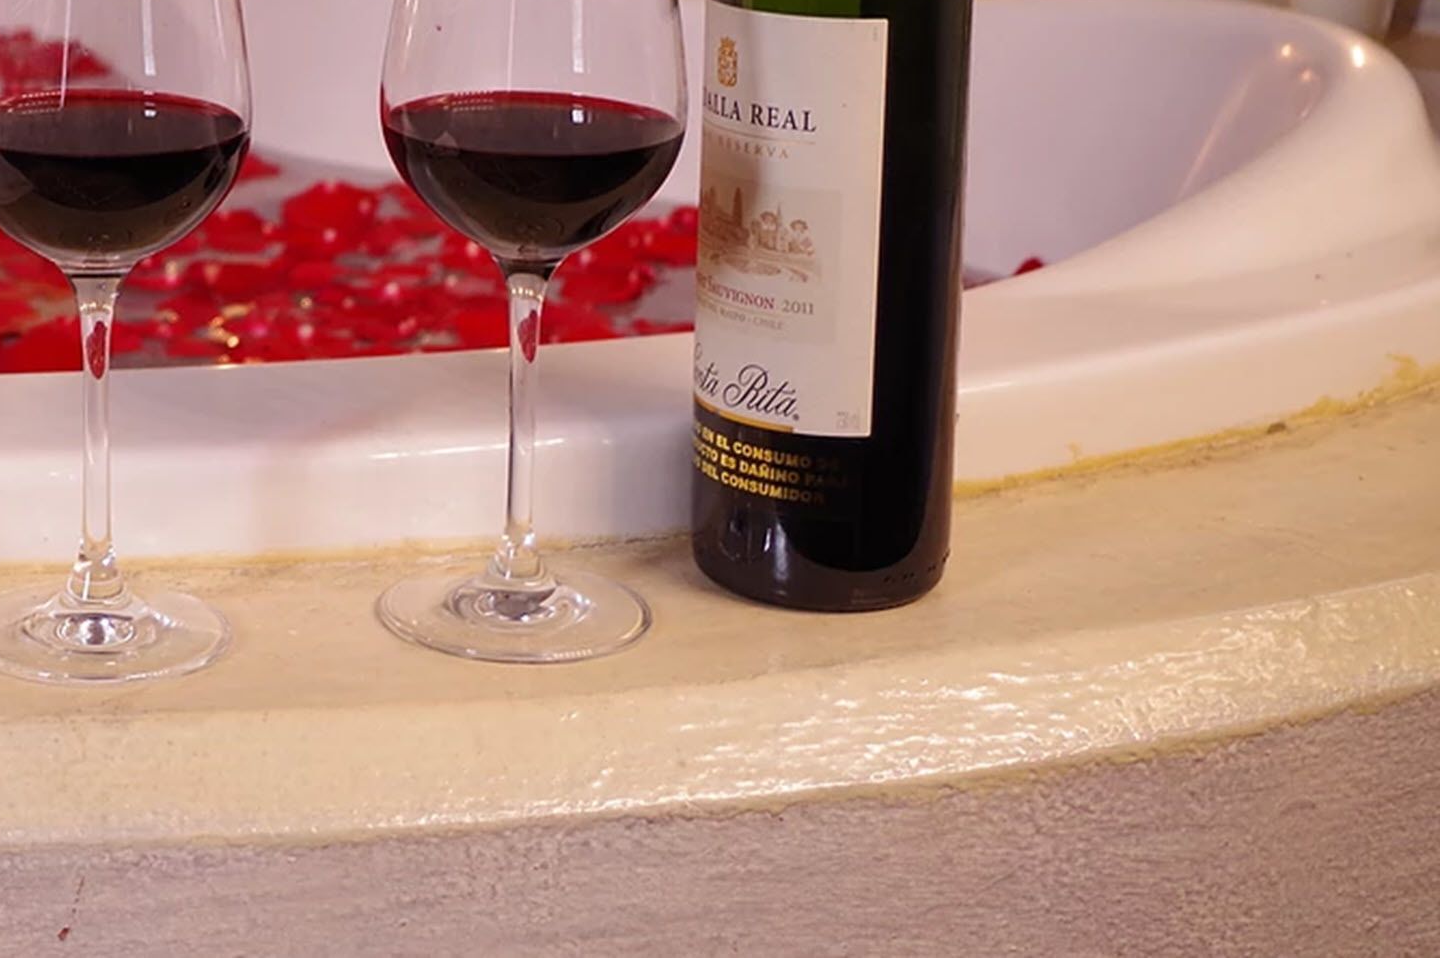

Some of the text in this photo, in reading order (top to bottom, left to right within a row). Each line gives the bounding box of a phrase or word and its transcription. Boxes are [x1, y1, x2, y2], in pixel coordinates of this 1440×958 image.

[750, 103, 817, 132] REAL
[782, 299, 815, 315] 2011
[716, 433, 731, 452] EL
[732, 440, 813, 469] CONSUMO
[720, 453, 737, 470] ES
[738, 460, 801, 485] DAÑINO
[720, 471, 825, 503] CONSUMIDOR
